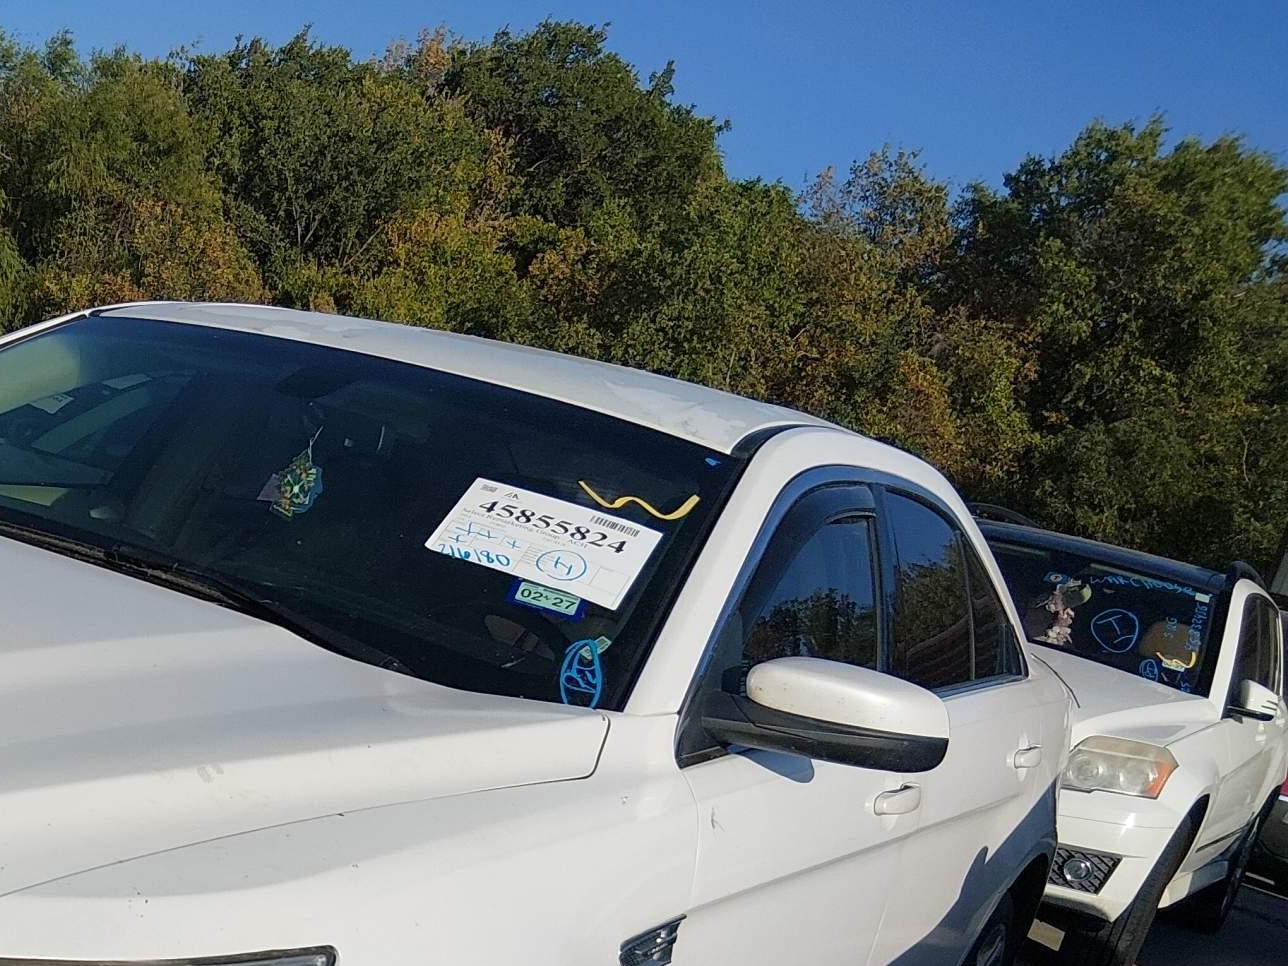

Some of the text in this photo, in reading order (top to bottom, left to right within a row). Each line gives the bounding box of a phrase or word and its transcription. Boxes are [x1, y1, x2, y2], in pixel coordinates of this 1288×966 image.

[478, 500, 627, 554] 45855824
[520, 588, 577, 610] 02 27
